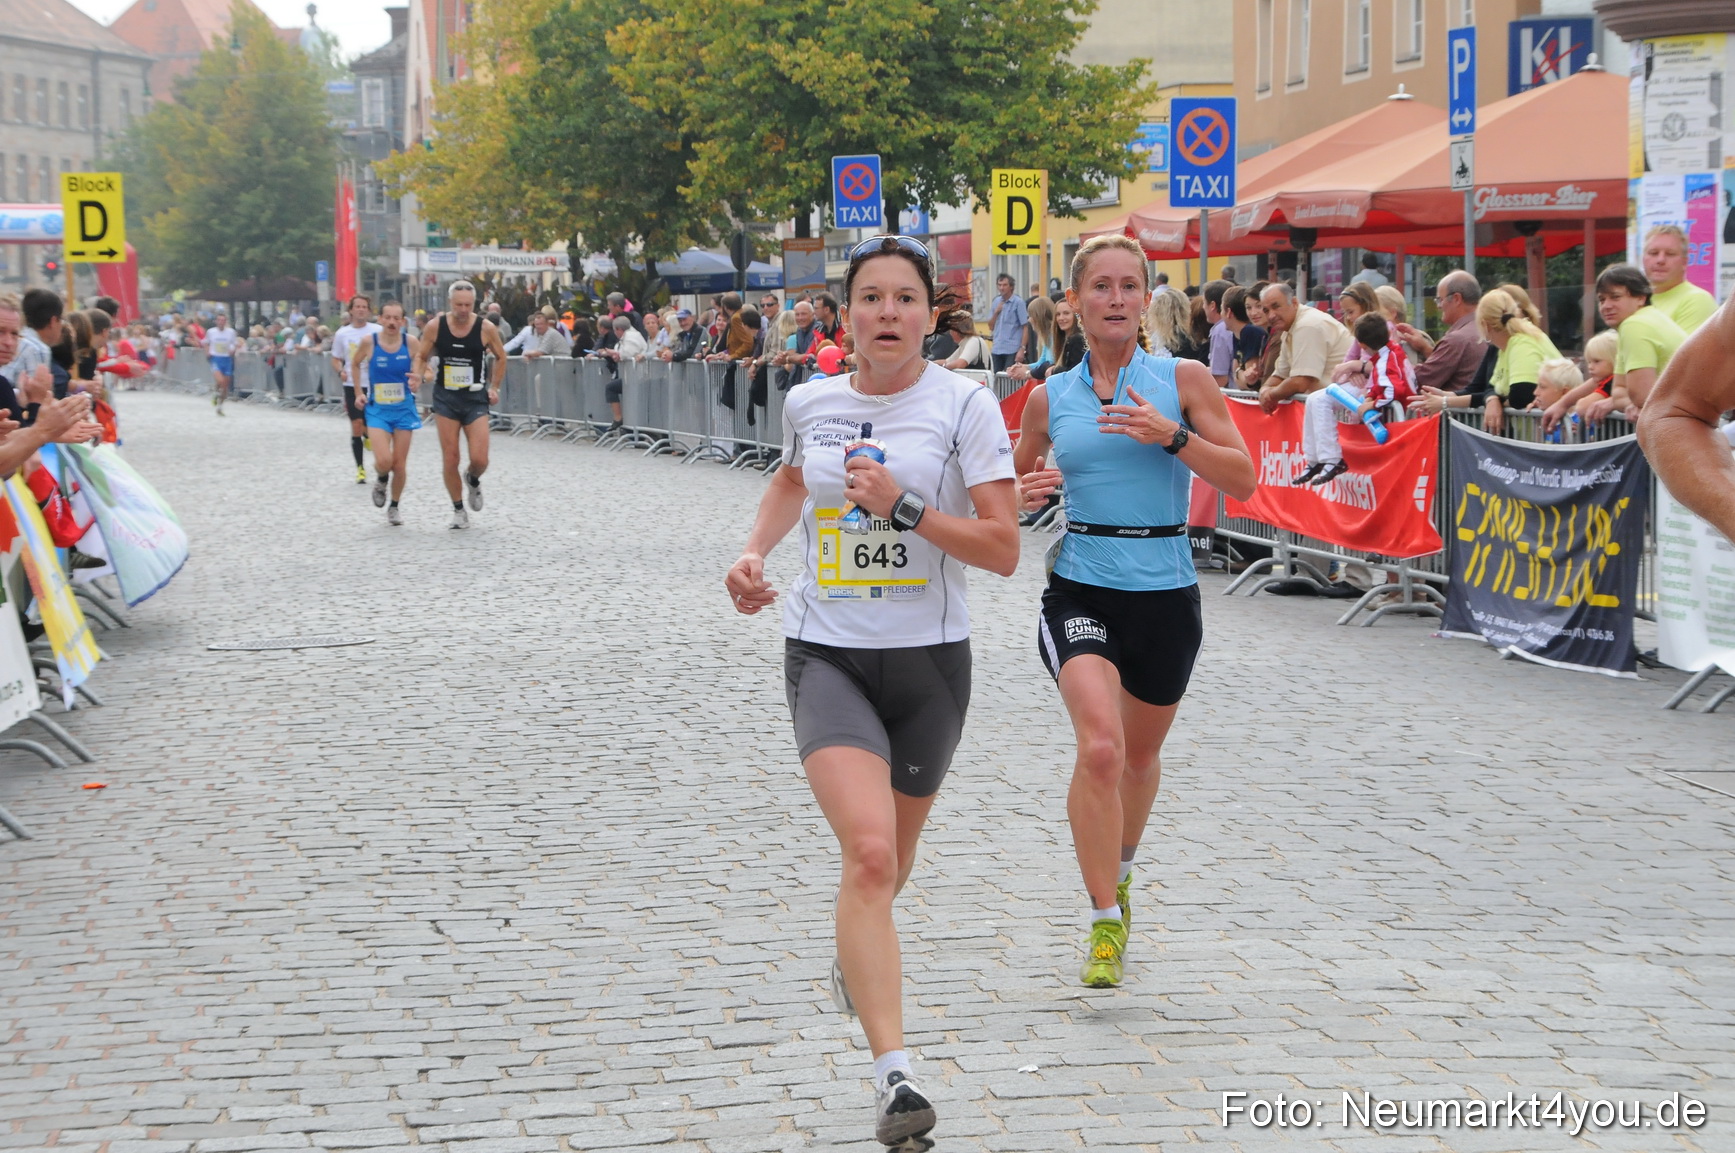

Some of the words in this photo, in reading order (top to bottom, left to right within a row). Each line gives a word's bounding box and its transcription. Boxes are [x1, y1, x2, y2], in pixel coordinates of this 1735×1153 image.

[1453, 38, 1471, 100] P
[67, 177, 115, 192] Block
[999, 174, 1041, 189] Block
[1176, 176, 1229, 198] TAXI
[79, 201, 108, 242] D
[839, 206, 878, 223] TAXI
[1006, 196, 1033, 235] D
[812, 418, 860, 431] LAUFFREUNDE
[823, 542, 829, 555] B
[854, 543, 908, 568] 643
[883, 585, 926, 594] PFLEIDERER
[1067, 619, 1091, 628] GEH
[1068, 625, 1104, 636] PUNKT
